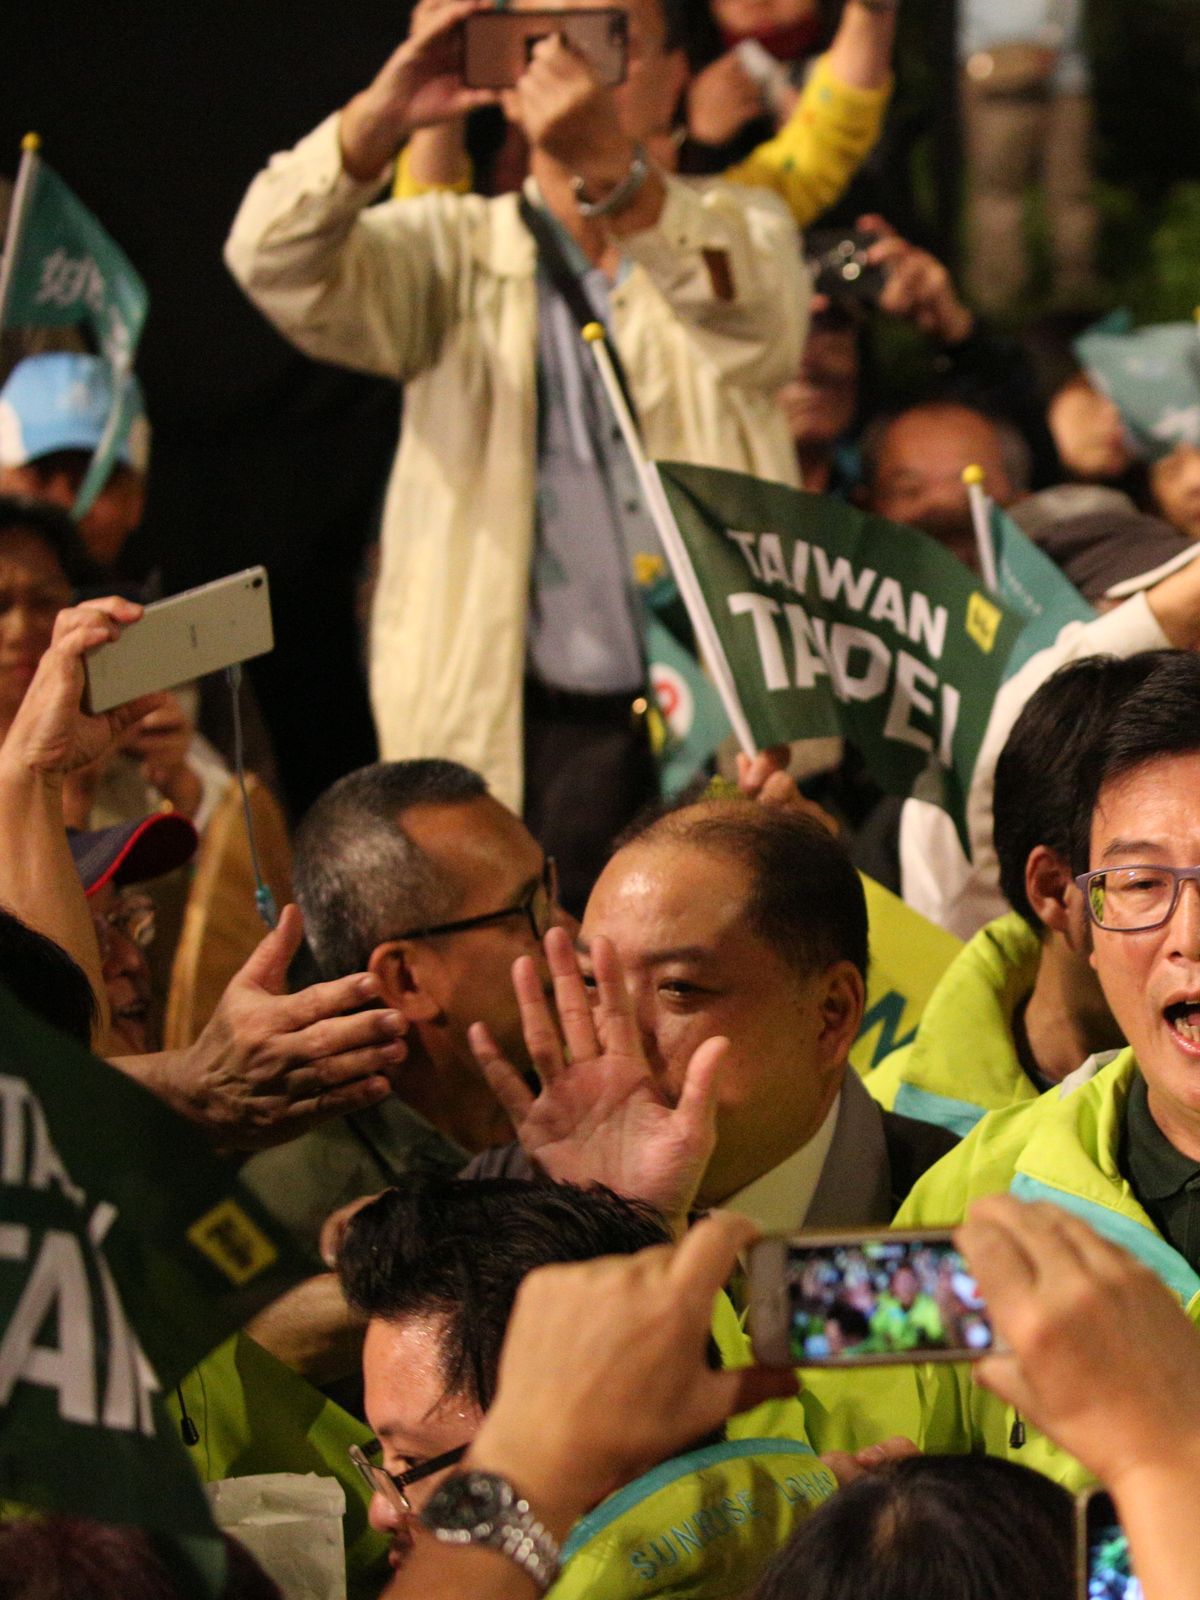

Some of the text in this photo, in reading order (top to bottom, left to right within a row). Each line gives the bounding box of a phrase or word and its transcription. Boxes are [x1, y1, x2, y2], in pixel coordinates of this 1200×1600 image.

[726, 532, 948, 660] TAIWAN
[727, 592, 960, 768] TAPEI
[629, 1490, 764, 1580] SUNRISE
